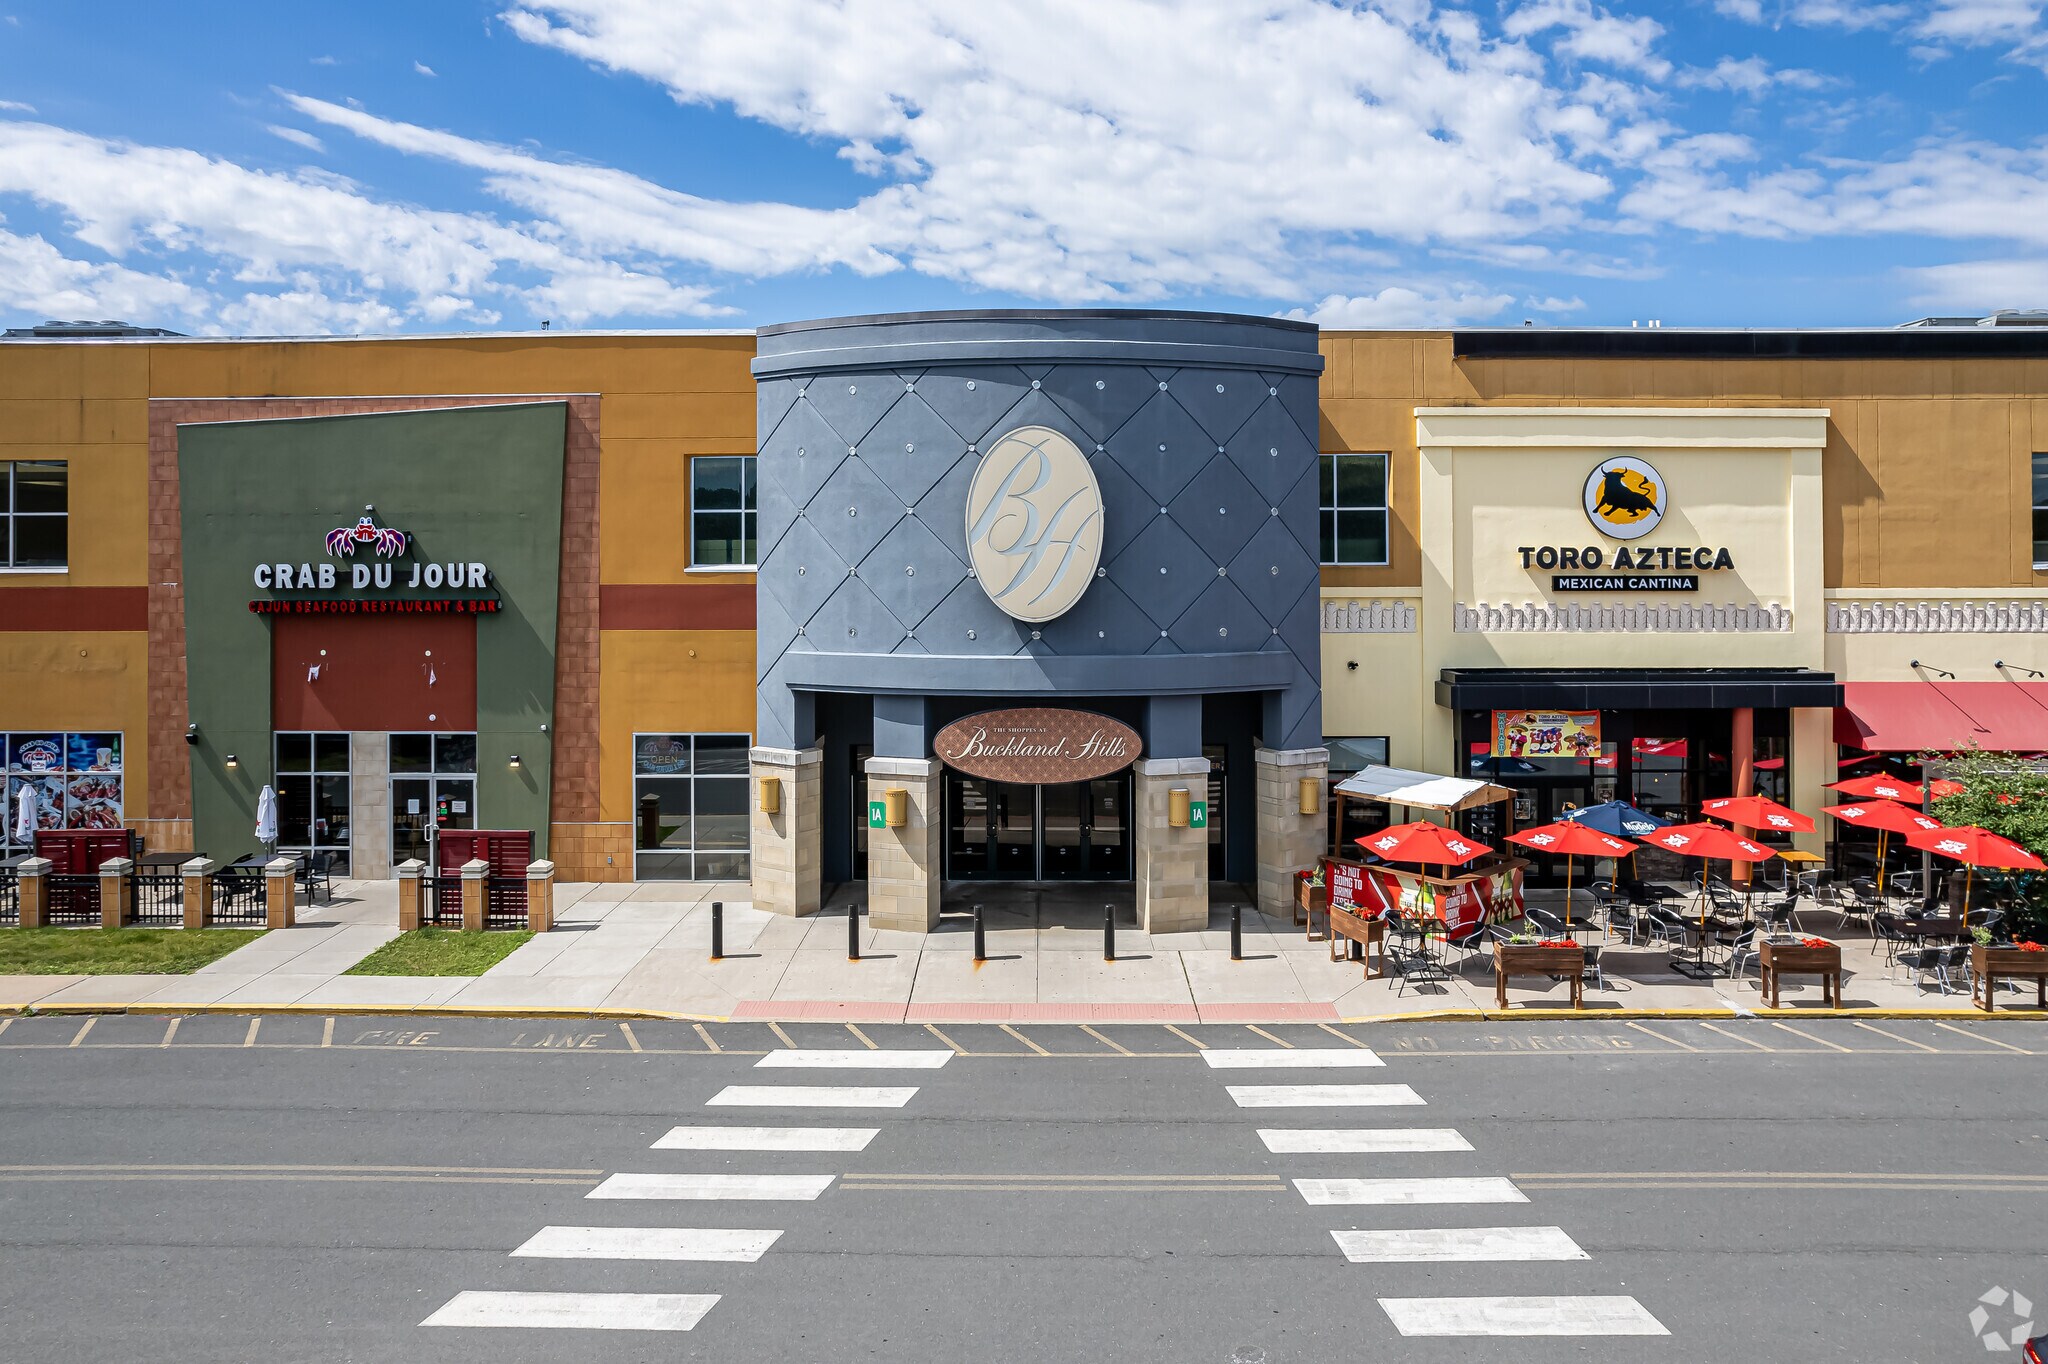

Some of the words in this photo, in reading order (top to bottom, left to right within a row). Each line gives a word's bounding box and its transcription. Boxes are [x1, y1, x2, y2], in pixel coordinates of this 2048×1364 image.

[1518, 546, 1603, 571] TORO
[1611, 546, 1735, 571] AZTECA
[253, 563, 337, 589] CRAB
[352, 563, 393, 589] DU
[408, 562, 488, 588] JOUR
[1558, 578, 1624, 590] MEXICAN
[1628, 578, 1693, 590] CANTINA
[248, 600, 291, 613] CAJUN
[295, 600, 357, 613] SEAFOOD
[362, 600, 450, 613] RESTAURANT
[455, 600, 465, 613] &
[469, 600, 496, 613] BAR
[946, 726, 1066, 760] Buckland
[1065, 728, 1126, 760] Hills
[651, 755, 678, 764] OPEN
[872, 808, 882, 821] 1A
[1193, 808, 1203, 821] 1A
[1622, 821, 1656, 832] Modelo
[1348, 867, 1361, 879] NOT
[1333, 874, 1353, 888] GOING
[1354, 879, 1363, 890] TO
[1333, 885, 1353, 899] DRINK
